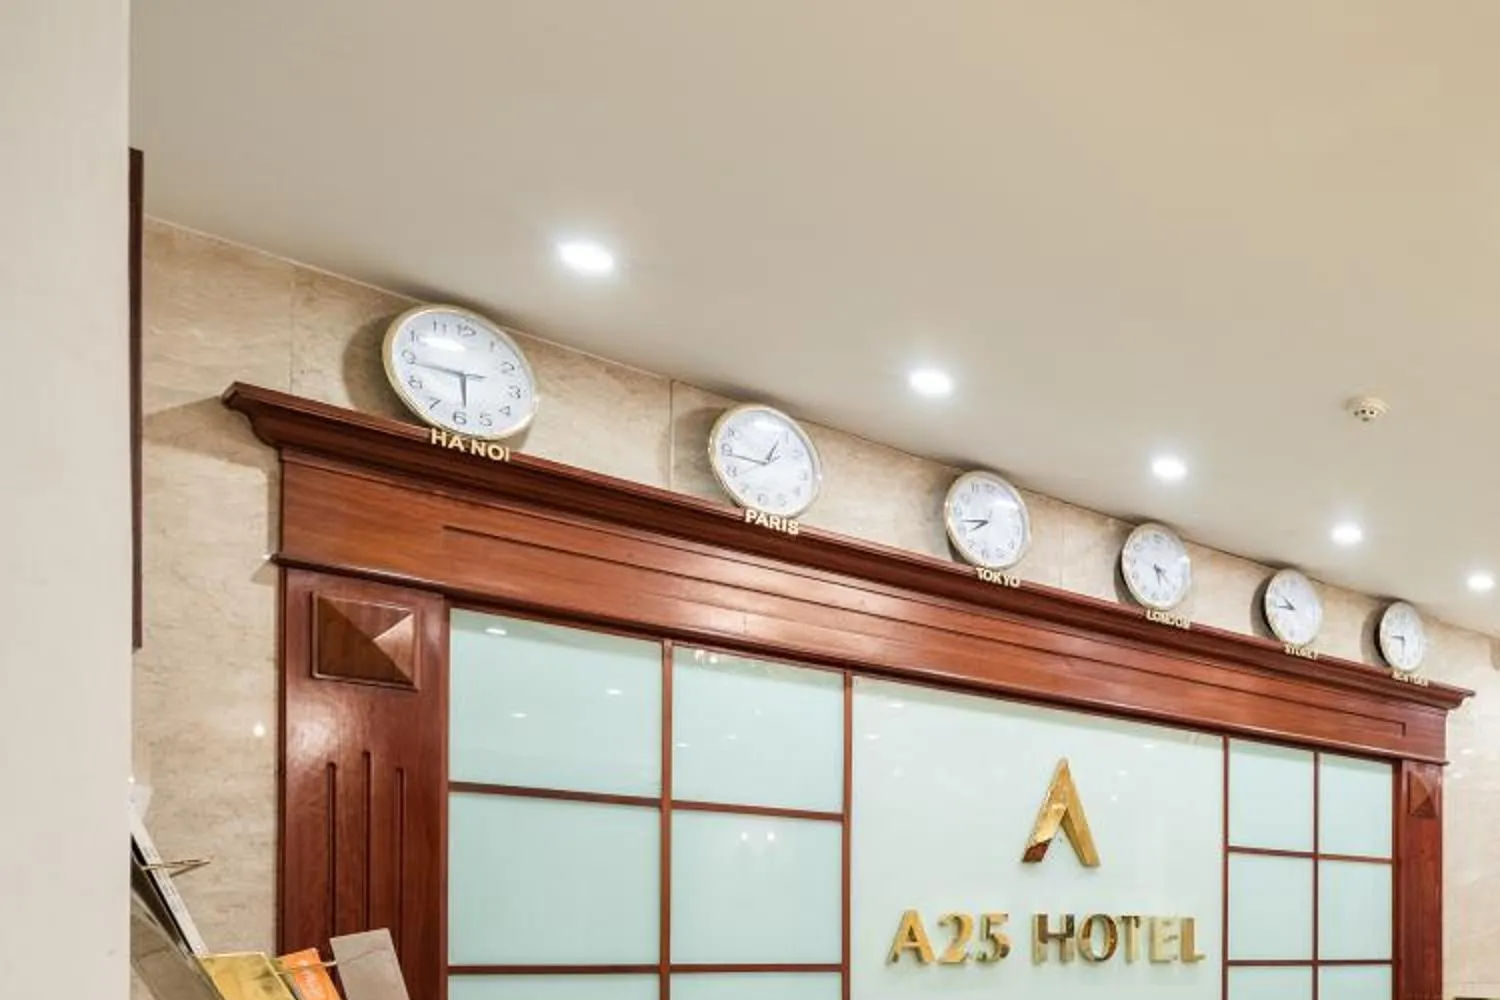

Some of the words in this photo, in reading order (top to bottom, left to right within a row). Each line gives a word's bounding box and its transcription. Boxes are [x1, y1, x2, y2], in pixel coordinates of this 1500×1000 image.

[433, 320, 447, 335] 11
[457, 324, 477, 338] 12
[401, 350, 416, 365] 9
[501, 361, 515, 373] 2
[509, 385, 521, 399] 3
[426, 396, 442, 410] 7
[499, 405, 511, 416] 4
[453, 411, 467, 425] 6
[480, 412, 493, 427] 5
[744, 509, 800, 535] PARIS
[976, 567, 1020, 588] TOKYO
[886, 908, 1012, 965] A25
[1031, 912, 1206, 966] HOTEL
